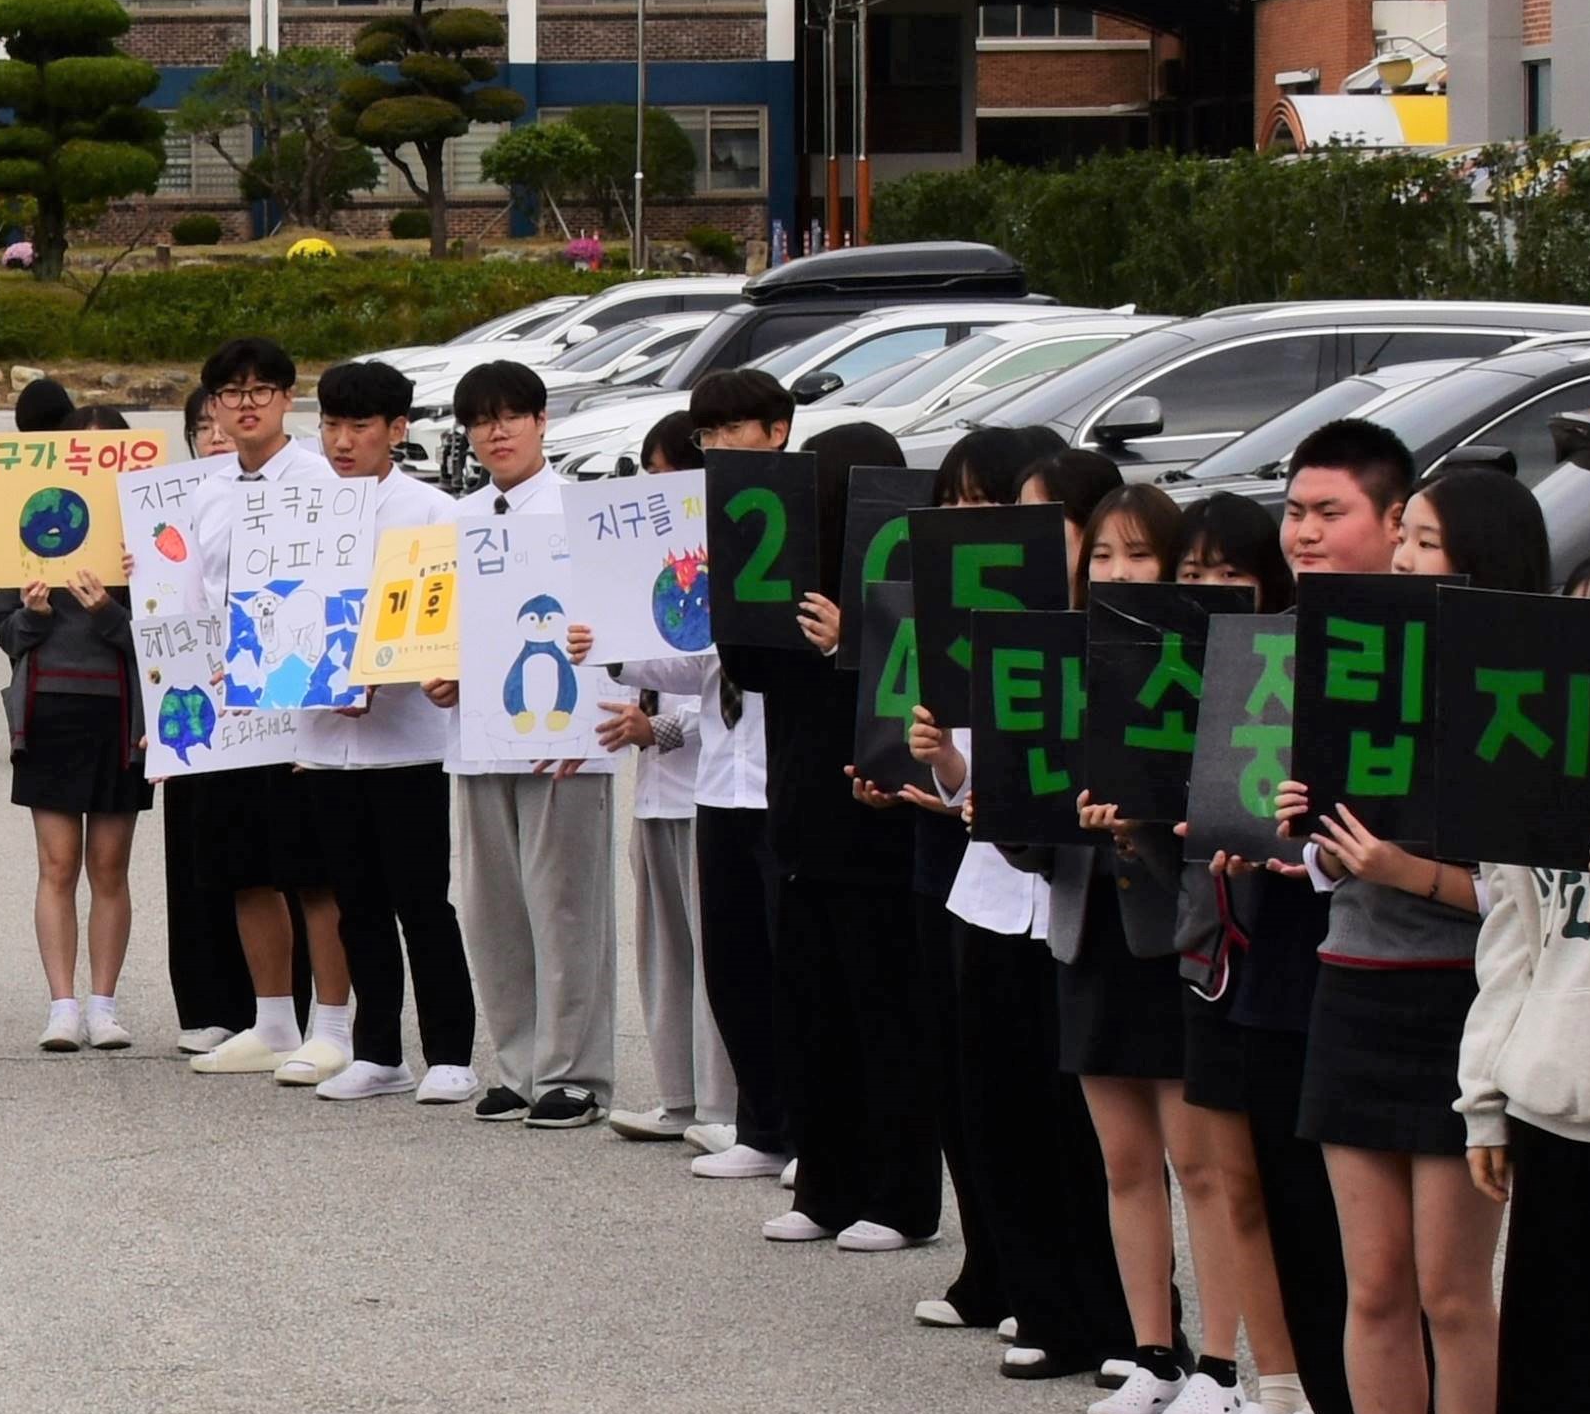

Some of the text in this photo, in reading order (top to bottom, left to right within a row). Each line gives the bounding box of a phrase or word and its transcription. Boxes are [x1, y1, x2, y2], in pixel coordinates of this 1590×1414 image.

[63, 437, 160, 473] 녹아요
[243, 483, 366, 535] 북극곰이
[587, 490, 674, 541] 지구를
[246, 531, 358, 577] 아파요
[465, 527, 529, 577] 집이
[723, 487, 792, 603] 2
[140, 615, 220, 658] 지구가
[1123, 631, 1204, 754] 소
[1322, 618, 1424, 797] 립
[220, 711, 297, 751] 도와주세요
[991, 647, 1088, 796] 탄
[1230, 632, 1297, 820] 중
